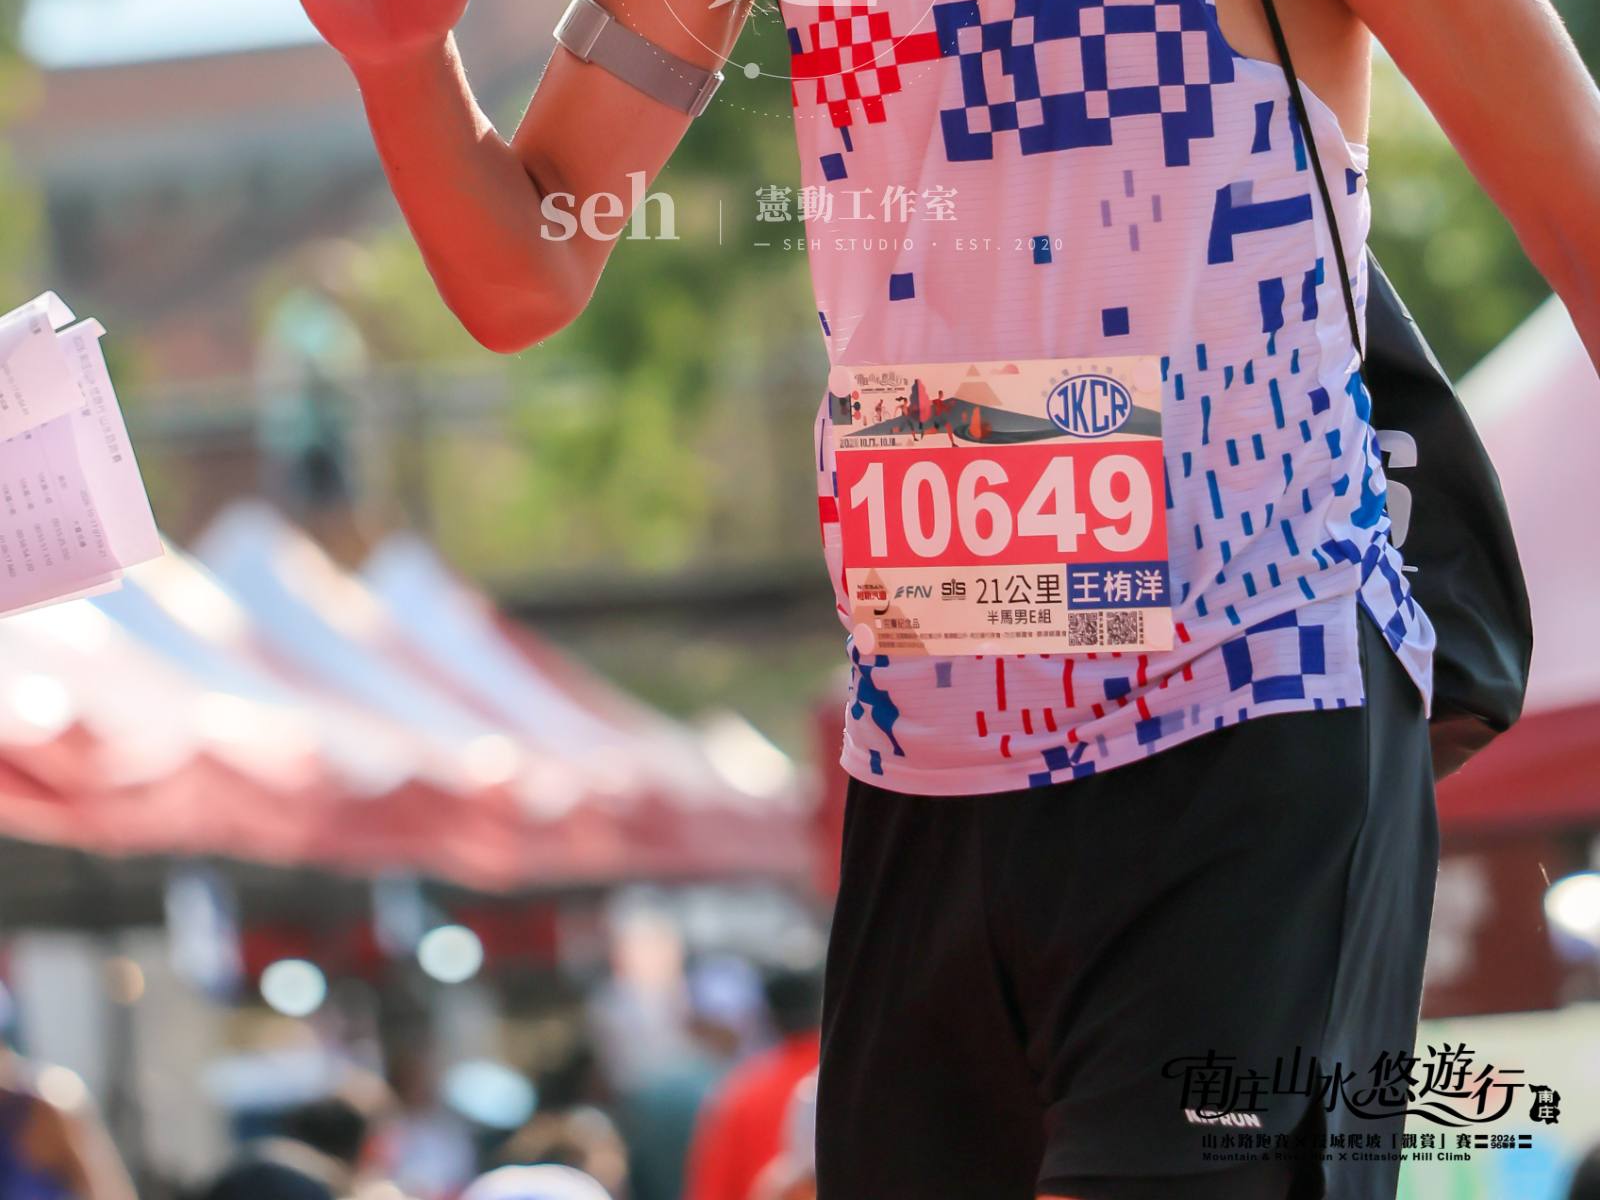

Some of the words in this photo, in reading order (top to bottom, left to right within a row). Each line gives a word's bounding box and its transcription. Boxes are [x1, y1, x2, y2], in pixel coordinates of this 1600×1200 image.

[1053, 379, 1130, 433] JKCR
[850, 454, 1153, 558] 10649
[975, 574, 1063, 605] 21公里
[1071, 569, 1164, 603] 王栯洋
[987, 608, 1052, 625] 半馬男E組
